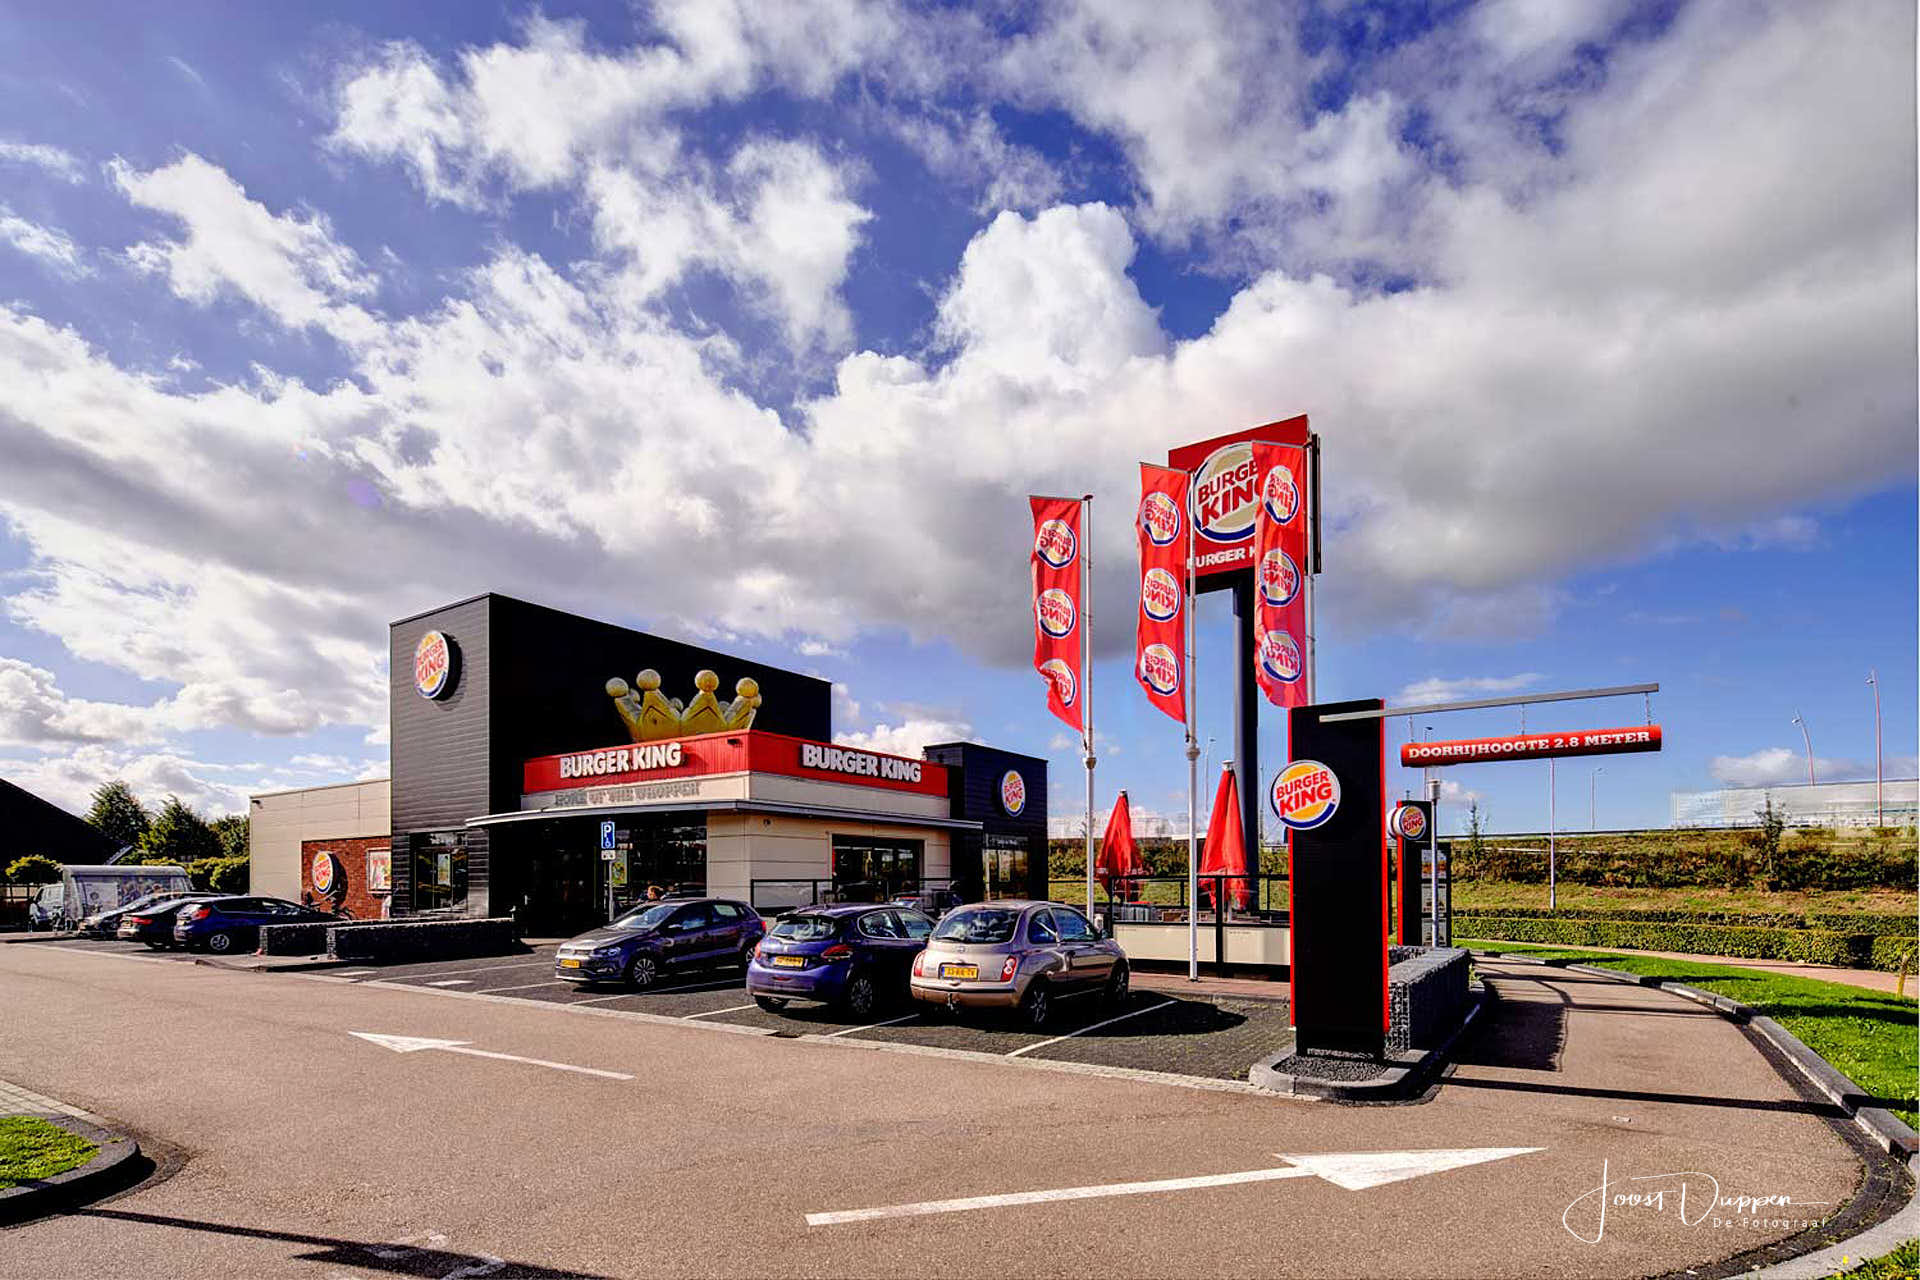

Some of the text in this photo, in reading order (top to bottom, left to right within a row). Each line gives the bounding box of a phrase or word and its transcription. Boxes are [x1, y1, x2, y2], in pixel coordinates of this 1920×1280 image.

[1198, 460, 1258, 505] BURGE
[417, 652, 445, 682] KING
[1408, 731, 1651, 758] DOORRIJHOOGTE 2.8 METER
[560, 742, 682, 778] BURGER KING
[802, 744, 921, 783] BURGER KING
[1276, 770, 1330, 800] BURGER
[1280, 782, 1332, 817] KING
[604, 824, 611, 838] P
[1403, 817, 1424, 833] KING
